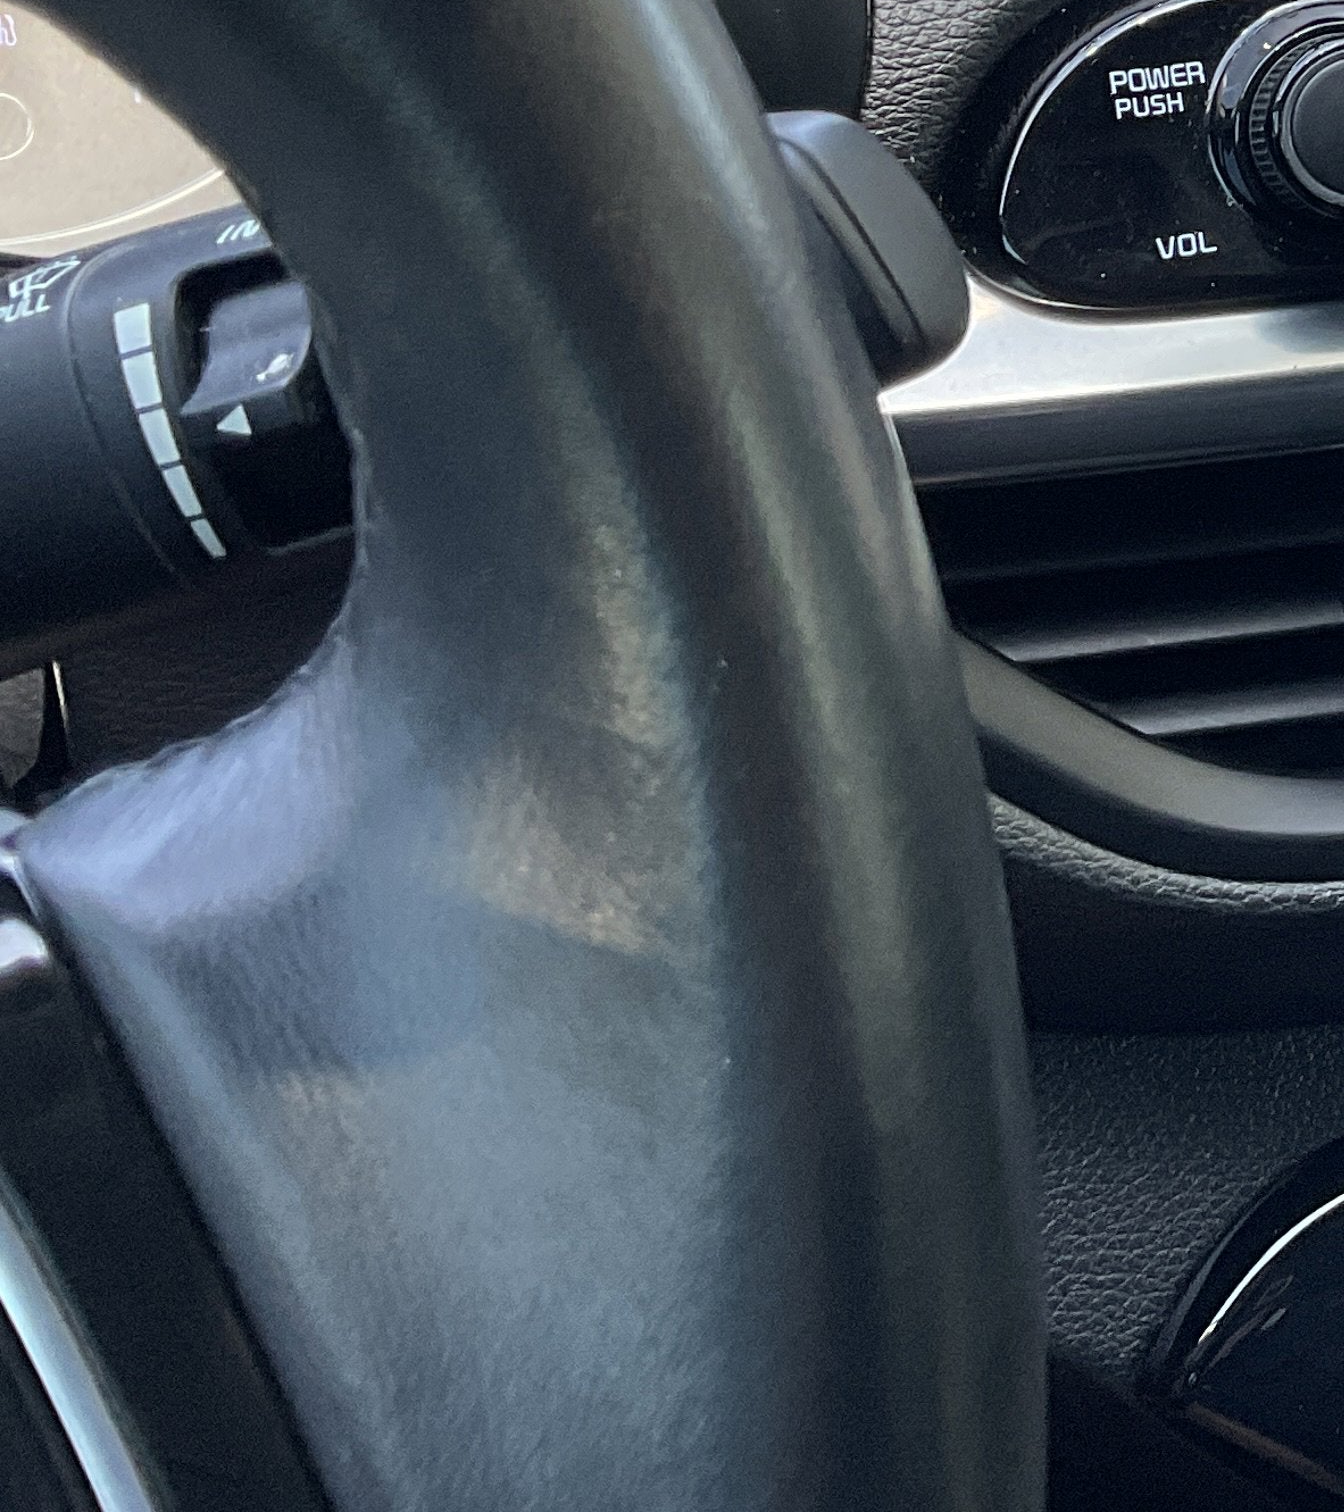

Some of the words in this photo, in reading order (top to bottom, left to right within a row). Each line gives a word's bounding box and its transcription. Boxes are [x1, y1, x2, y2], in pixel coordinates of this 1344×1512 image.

[1109, 61, 1205, 94] POWER
[1115, 92, 1184, 120] PUSH
[1155, 231, 1218, 260] VOL
